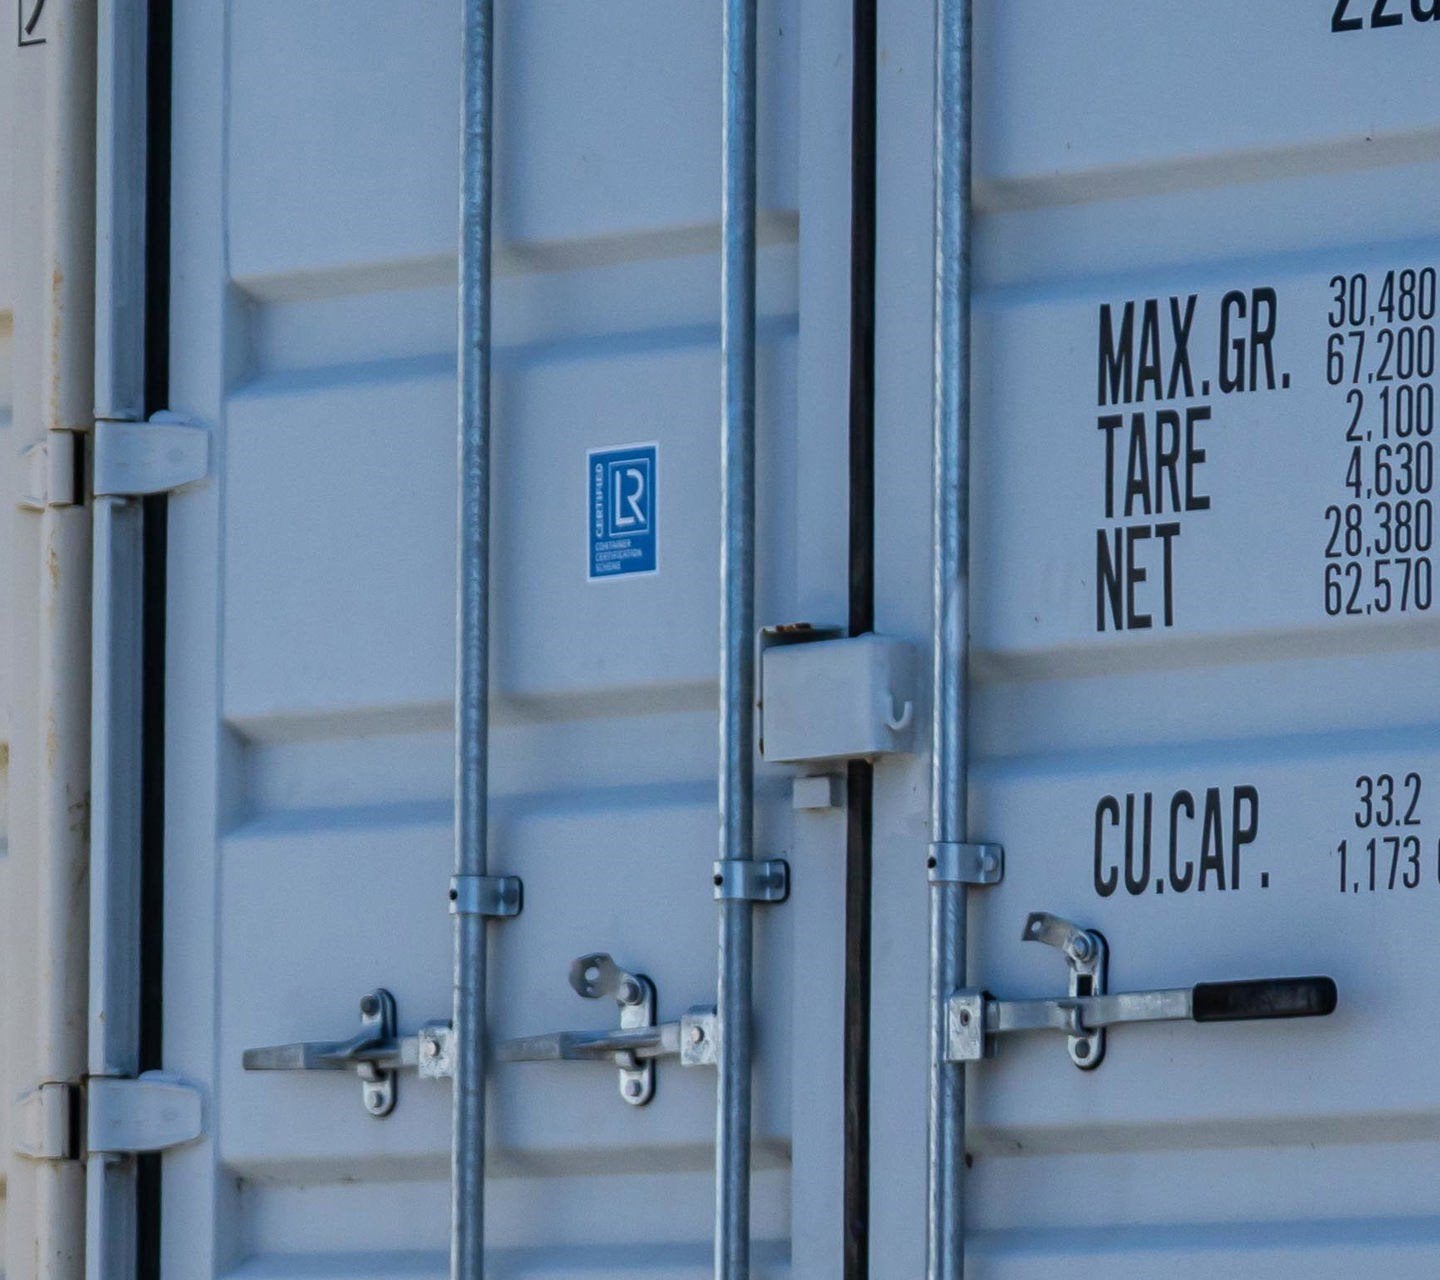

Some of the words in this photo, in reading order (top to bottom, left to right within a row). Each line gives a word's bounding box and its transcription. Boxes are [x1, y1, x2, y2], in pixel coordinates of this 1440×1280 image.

[1098, 286, 1290, 406] MAX.GR.
[1328, 267, 1436, 328] 30,480
[1327, 325, 1434, 385] 67,200
[1098, 406, 1212, 518] TARE
[1346, 383, 1434, 442] 2,100
[1345, 441, 1433, 499] 4,630
[615, 468, 646, 525] LR
[1097, 522, 1180, 631] NET
[1325, 499, 1432, 558] 28,380
[1325, 557, 1432, 615] 62,570
[1094, 786, 1270, 897] CU.CAP.
[1355, 772, 1421, 828] 33.2
[1337, 835, 1421, 893] 1,173
